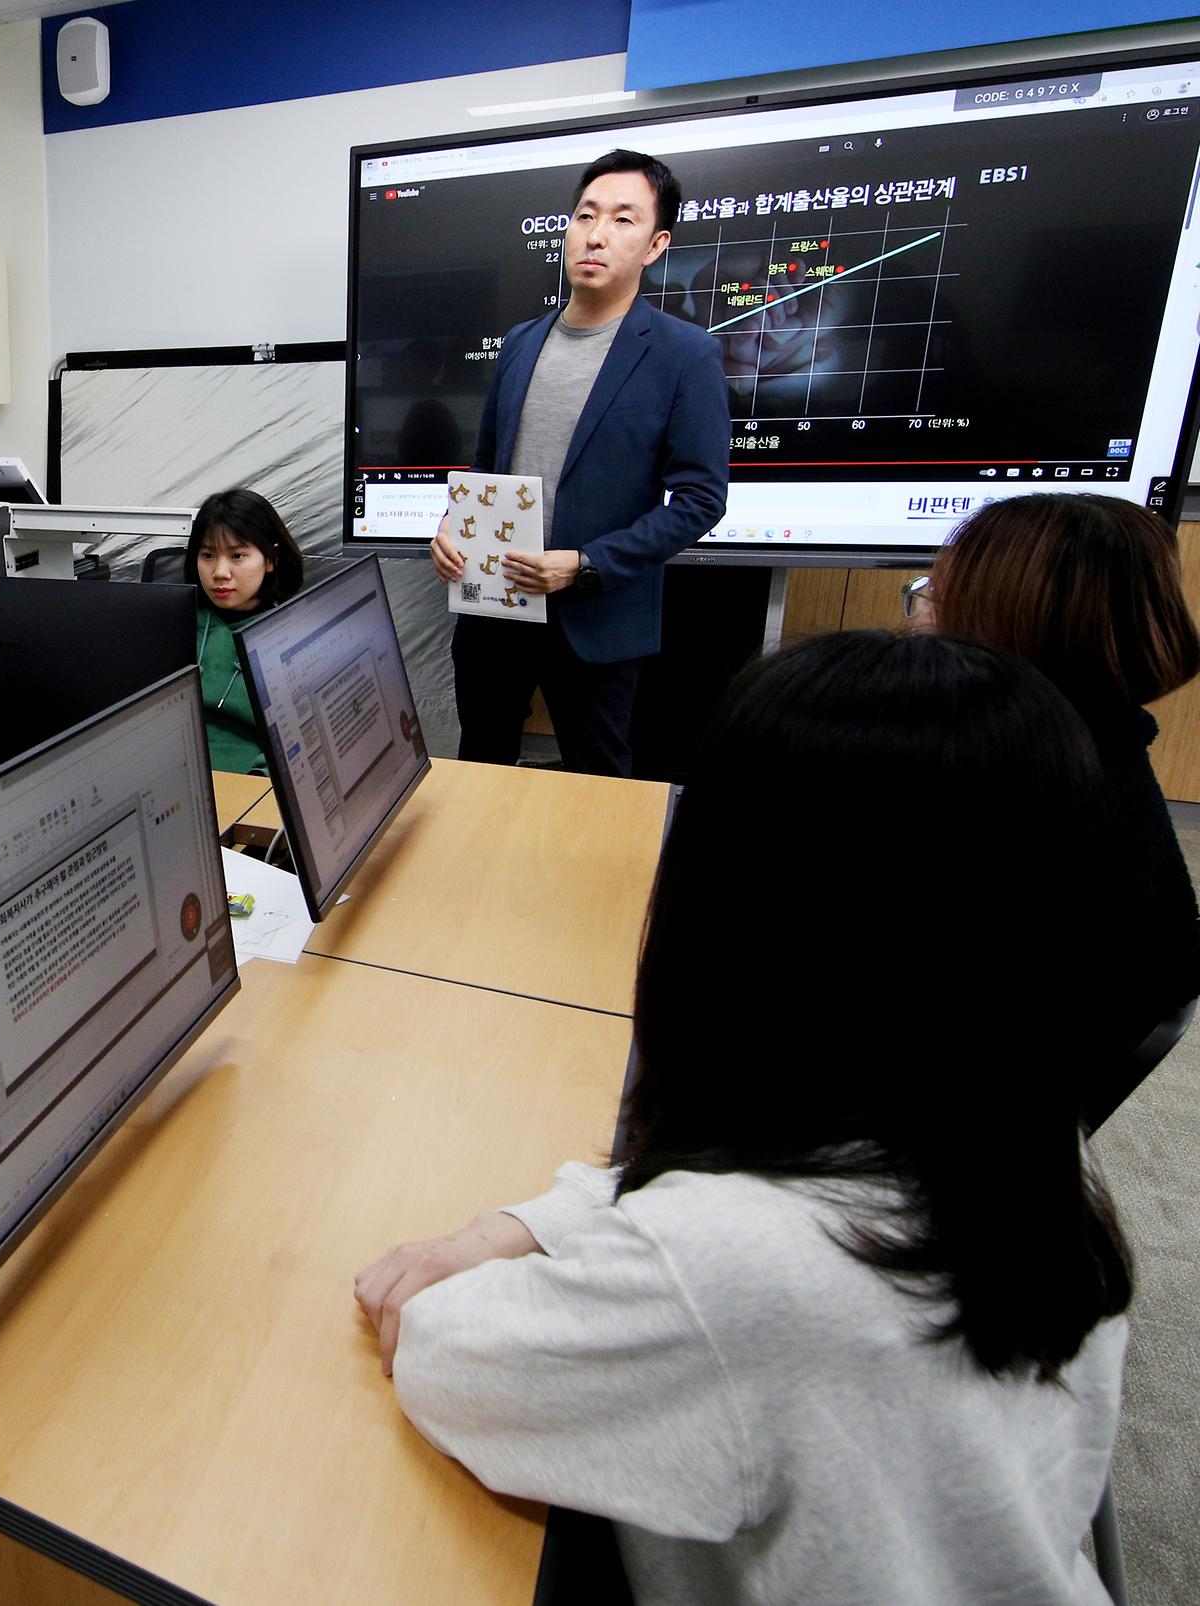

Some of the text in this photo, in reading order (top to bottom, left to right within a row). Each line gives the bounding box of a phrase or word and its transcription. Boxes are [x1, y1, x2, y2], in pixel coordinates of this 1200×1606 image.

[974, 92, 1010, 104] CODE:
[1162, 106, 1190, 117] 로그인
[979, 165, 1028, 184] EBS1
[521, 176, 956, 235] OECD 출산율과 합계출산율의 상관관계
[527, 239, 549, 250] (단위:
[789, 240, 820, 253] 프랑스
[545, 253, 559, 263] 2.2
[768, 262, 788, 275] 영국
[805, 265, 835, 278] 스웨덴
[721, 282, 740, 294] 미국
[544, 296, 557, 306] 1.9
[727, 294, 764, 307] 네덜란드
[482, 336, 506, 350] 합계
[744, 421, 758, 431] 40
[797, 421, 811, 431] 50
[851, 420, 866, 430] 60
[908, 419, 922, 429] 70
[927, 419, 955, 429] (단위:
